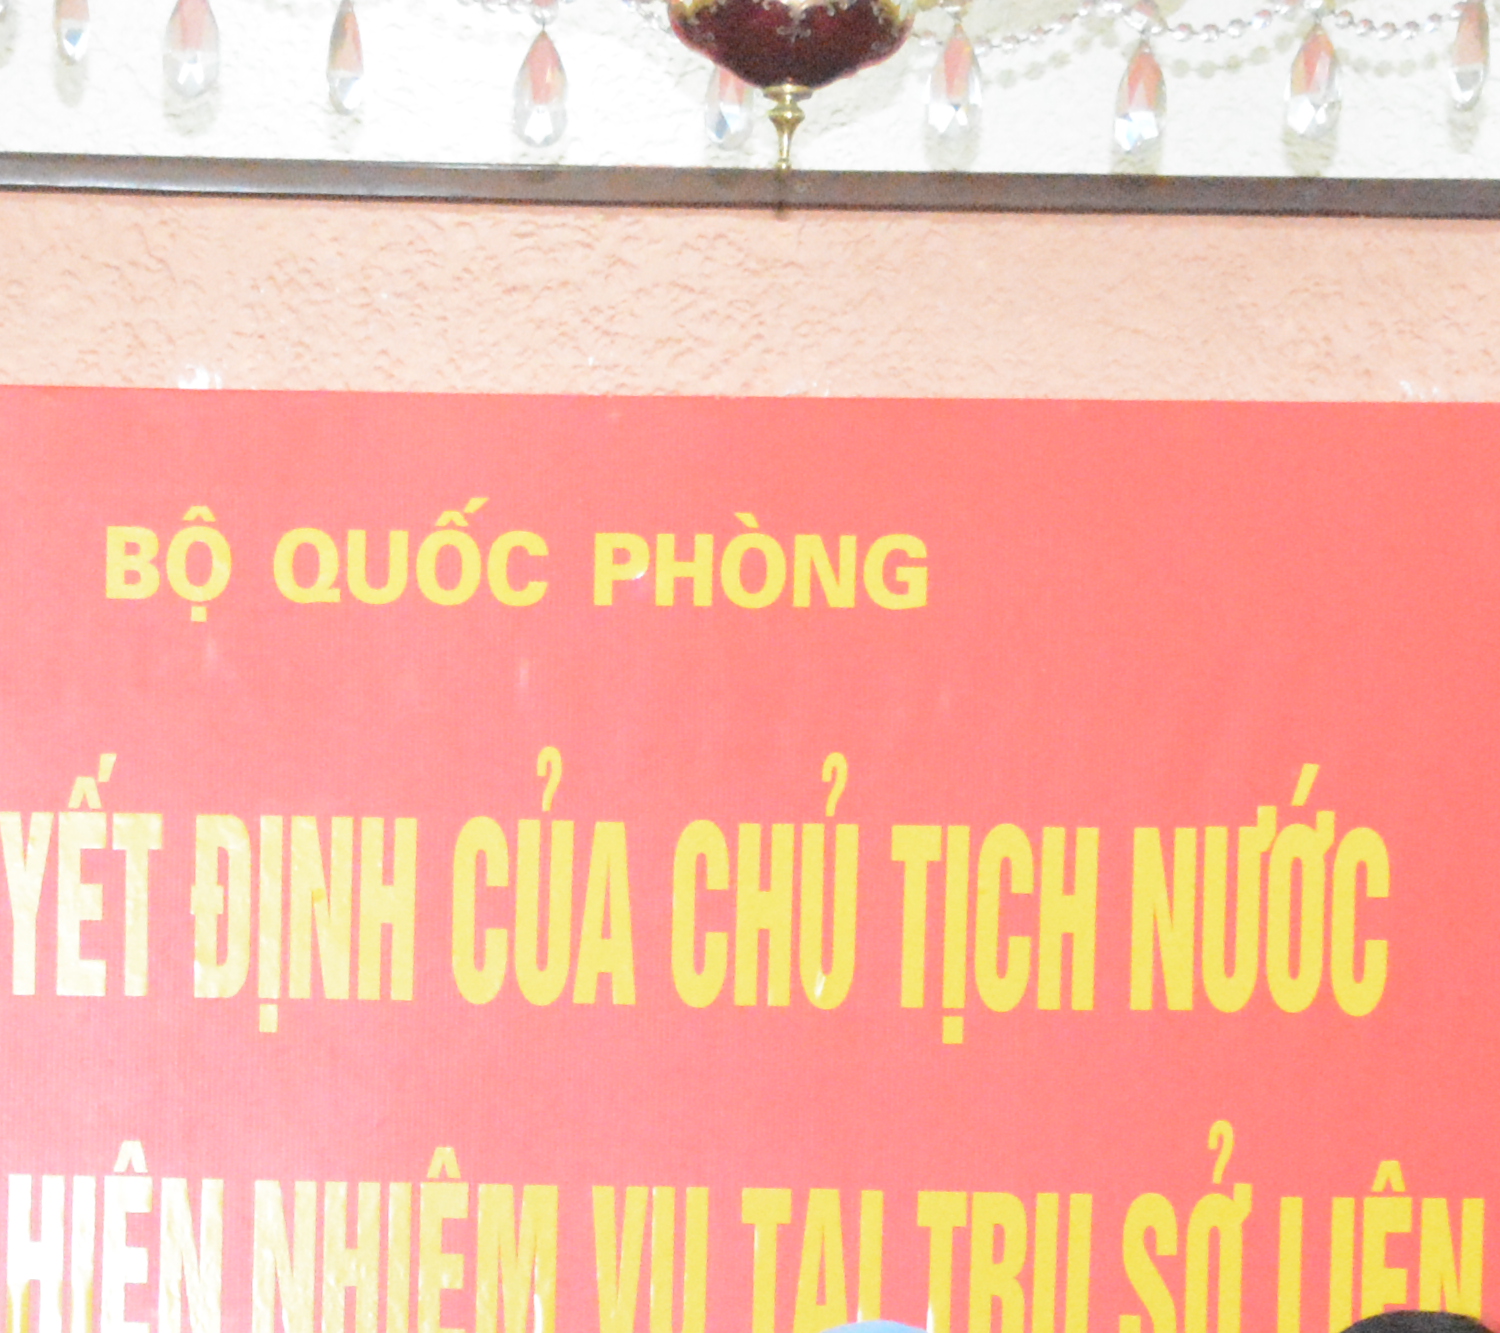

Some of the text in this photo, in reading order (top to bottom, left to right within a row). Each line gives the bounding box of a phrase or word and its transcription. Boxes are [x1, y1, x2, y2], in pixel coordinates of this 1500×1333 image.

[106, 497, 928, 621] BỘ QUỐC PHÒNG
[191, 813, 418, 1033] ĐỊNH
[452, 745, 636, 1006] CỦA
[671, 752, 859, 1010] CHỦ
[891, 823, 1099, 1044] TỊCH
[1130, 763, 1390, 1017] NƯỚC
